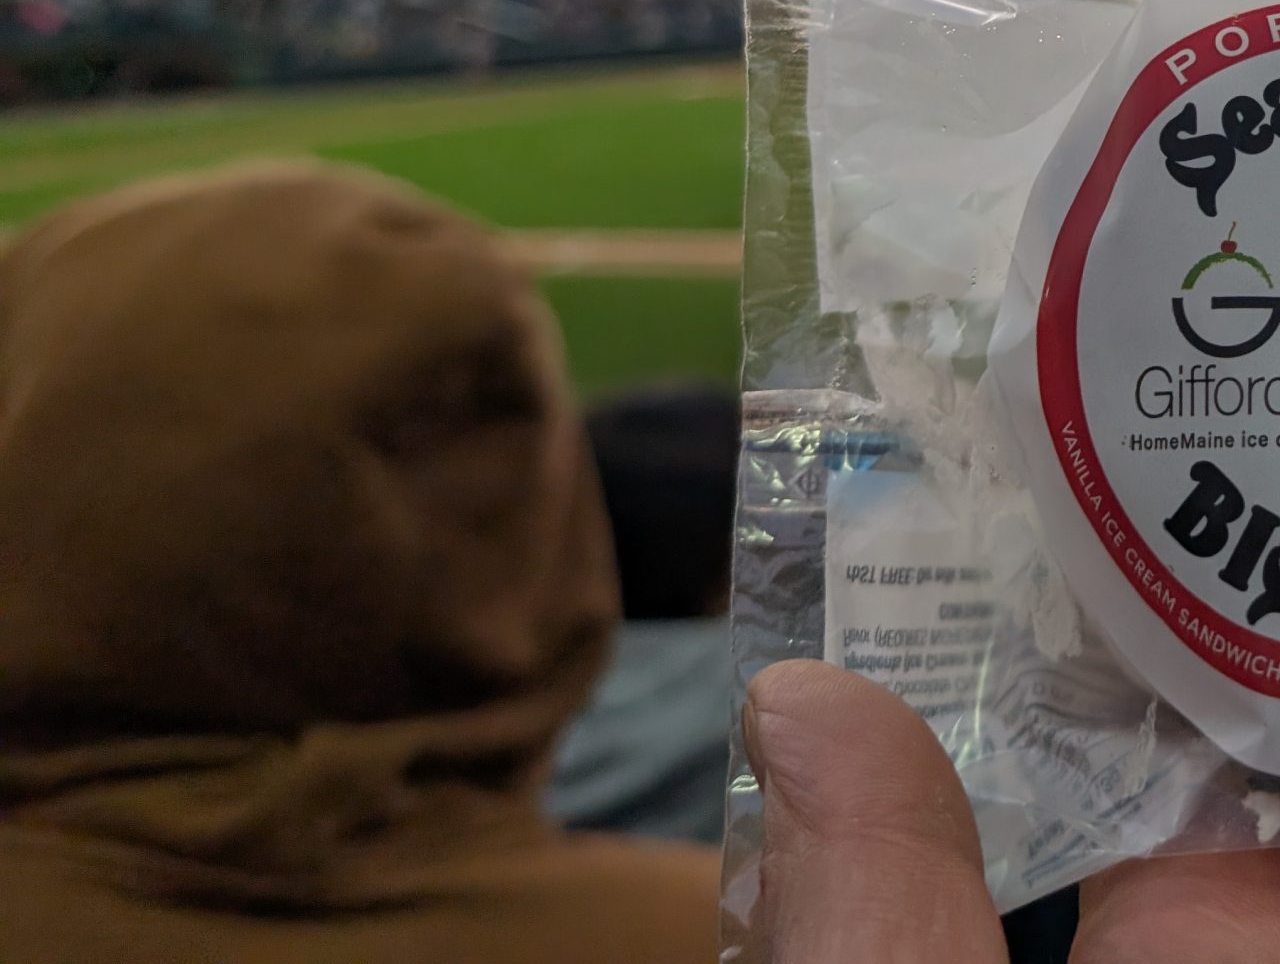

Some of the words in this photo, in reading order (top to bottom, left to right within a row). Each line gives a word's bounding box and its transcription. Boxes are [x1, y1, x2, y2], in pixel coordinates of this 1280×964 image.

[1130, 431, 1235, 451] HomeMaine
[1241, 430, 1269, 448] ice
[1061, 420, 1104, 511] VANILLA
[1101, 511, 1127, 547] ICE
[1124, 547, 1177, 613] CREAM
